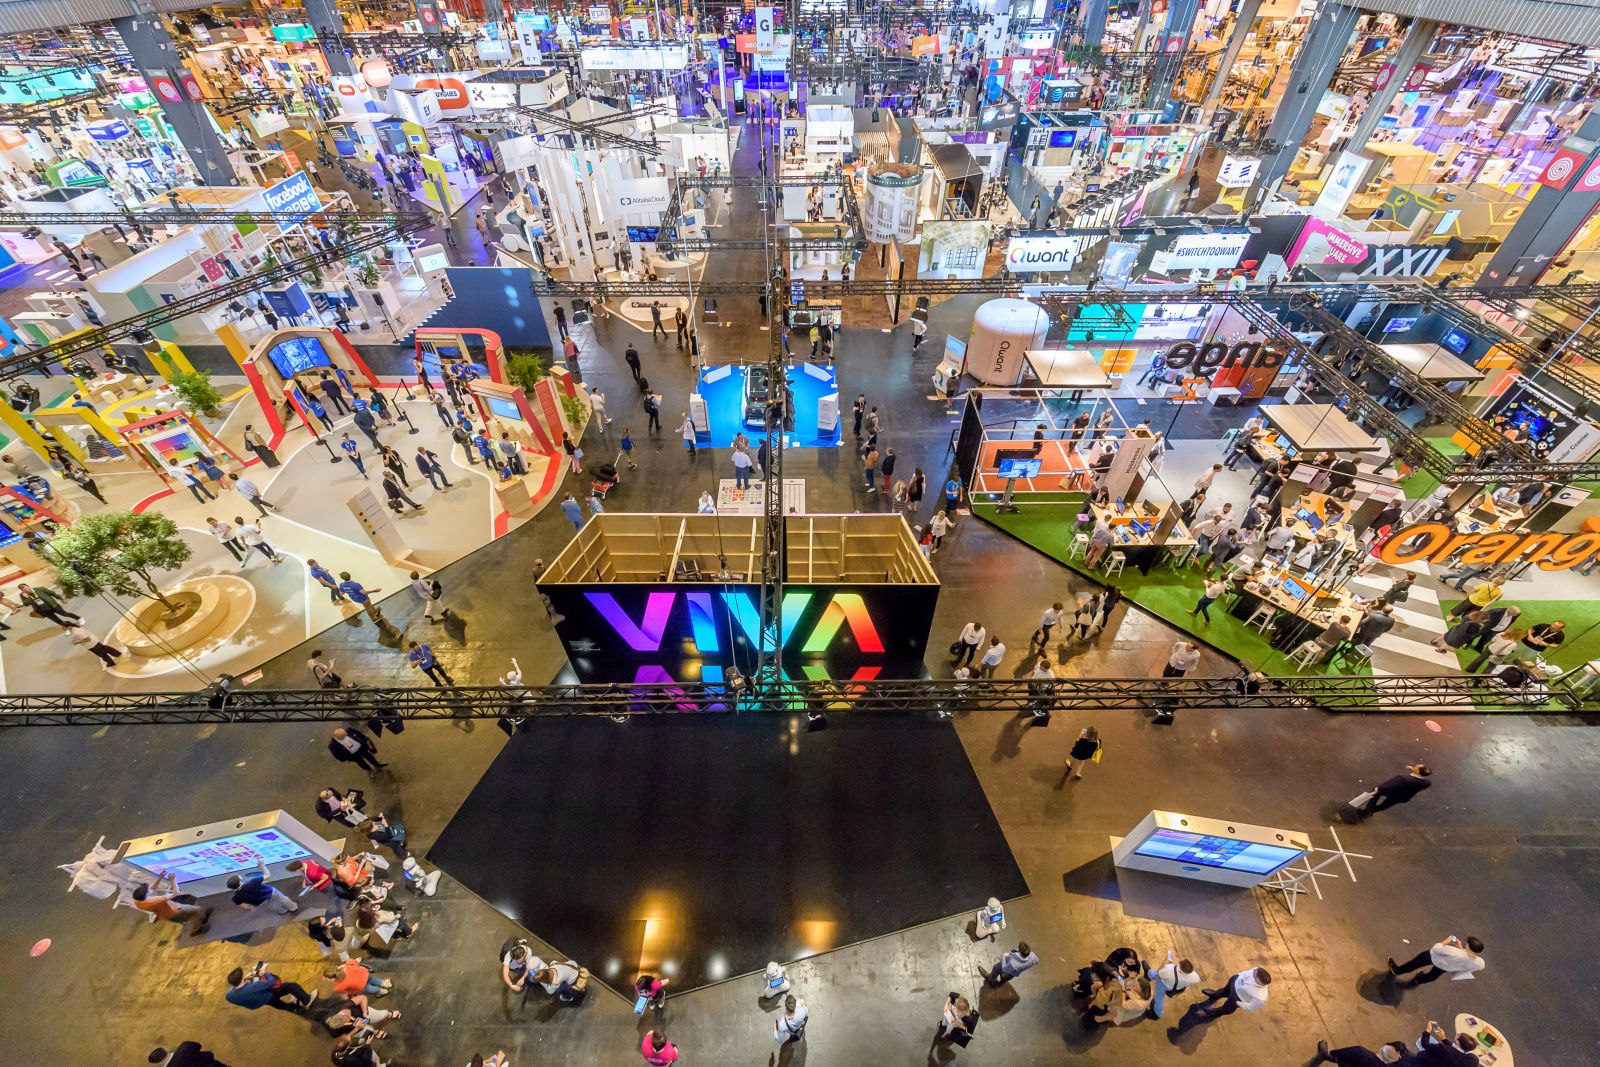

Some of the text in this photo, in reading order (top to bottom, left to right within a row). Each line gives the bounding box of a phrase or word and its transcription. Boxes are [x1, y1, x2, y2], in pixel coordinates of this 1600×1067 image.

[760, 18, 770, 32] G
[523, 33, 531, 46] E
[849, 29, 858, 43] H
[1063, 91, 1079, 99] AT&T
[423, 104, 431, 117] EY
[266, 177, 310, 208] facebook
[1175, 246, 1242, 257] #SWITCHTOQWANT
[1327, 232, 1363, 259] IMMERSIVE
[1010, 247, 1070, 265] Qwant
[1329, 246, 1348, 263] UARE
[1359, 248, 1451, 276] XXII
[993, 340, 1010, 373] Qwant
[1569, 432, 1590, 449] Coaster
[1381, 523, 1600, 572] Orang
[583, 592, 886, 654] VIVA
